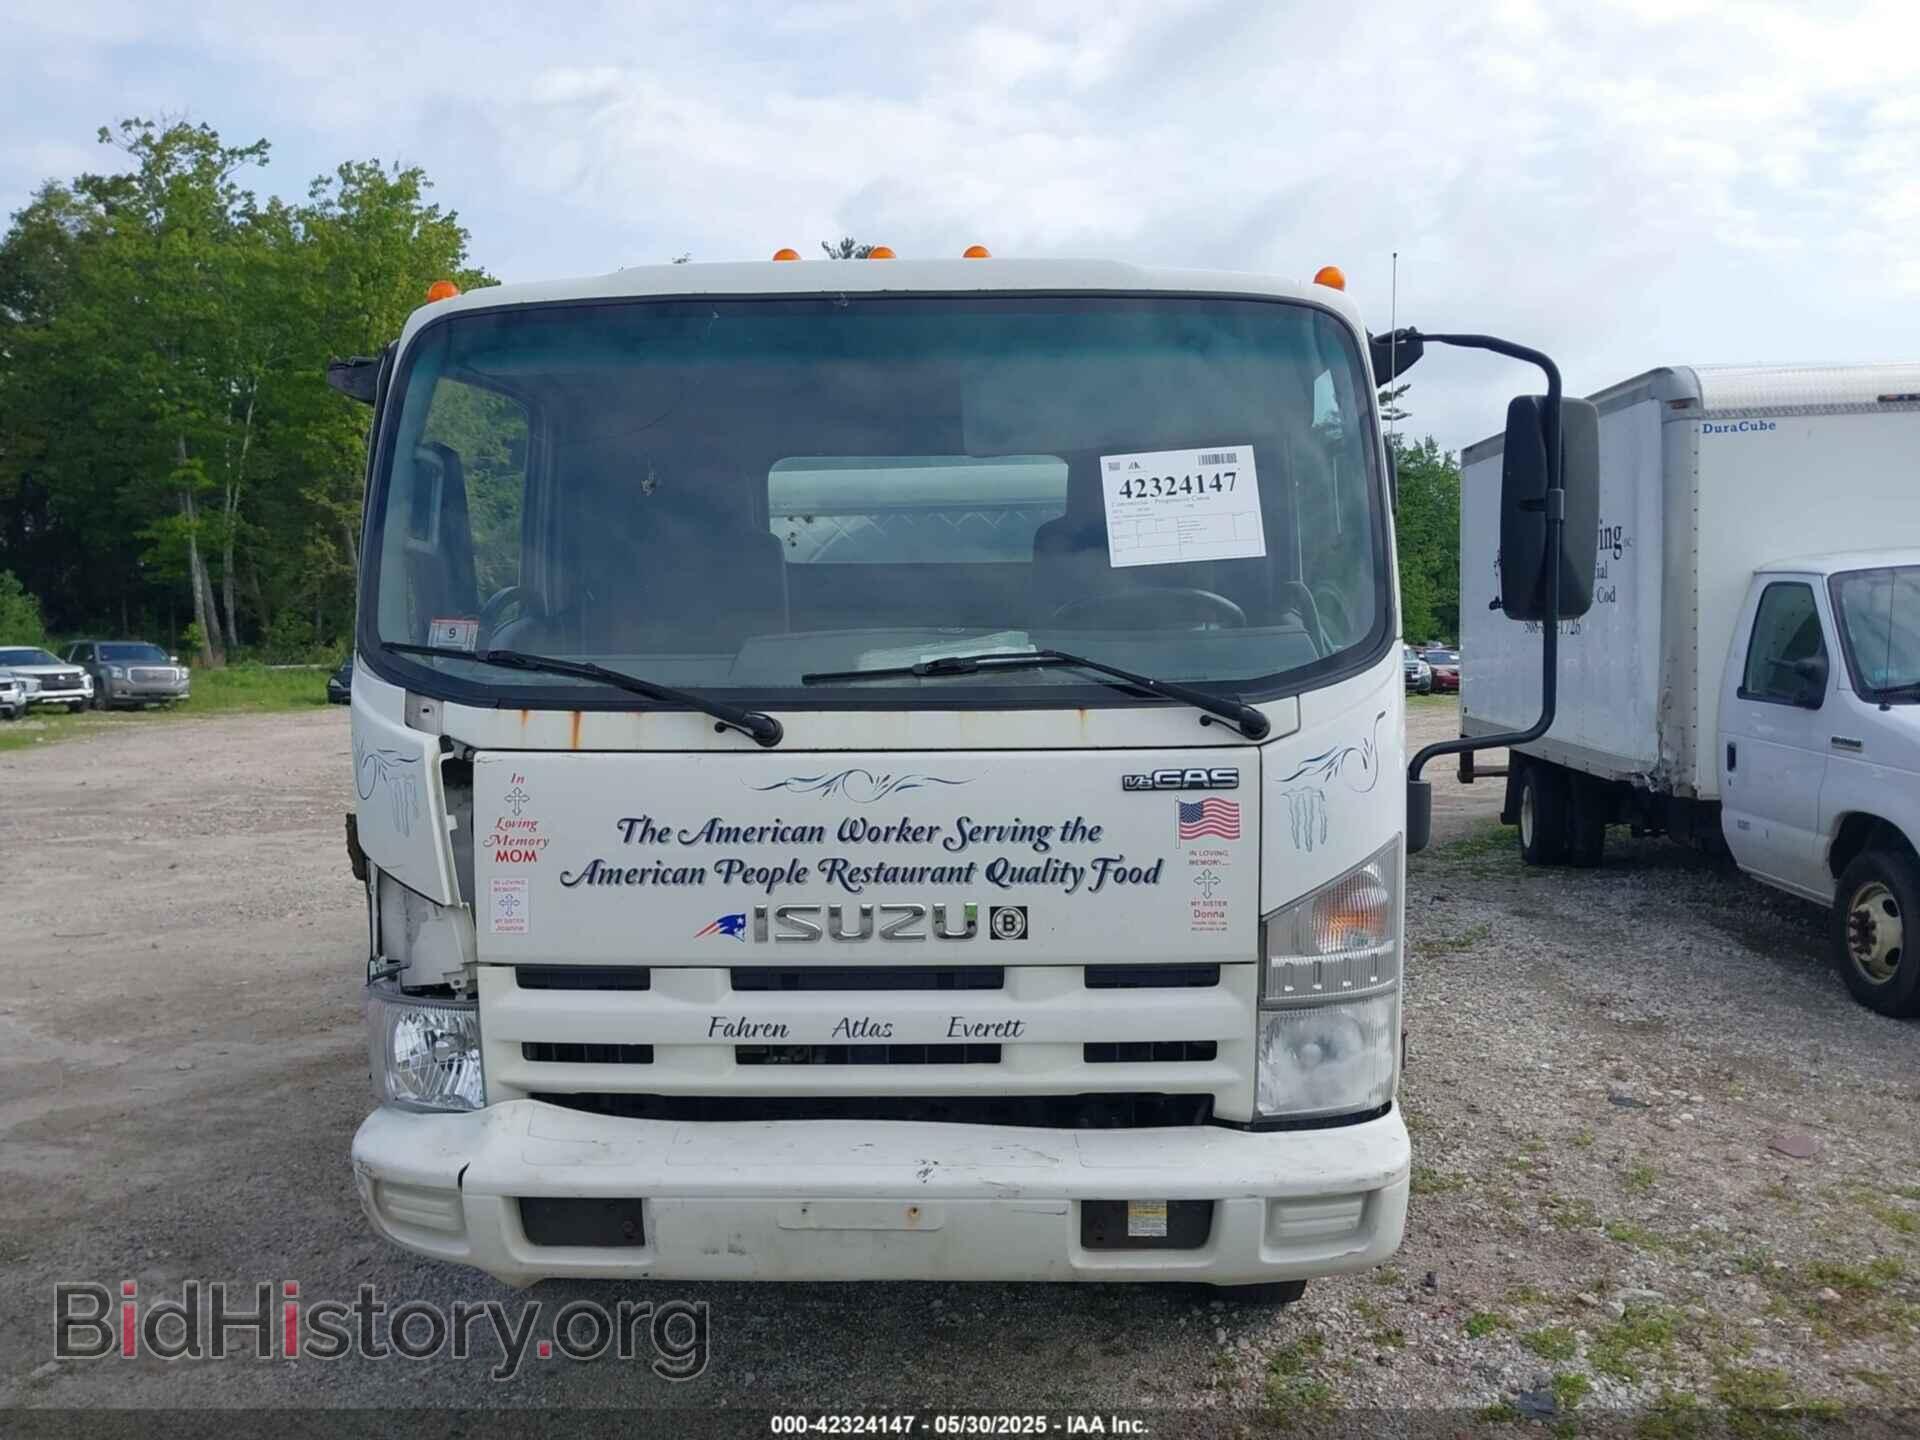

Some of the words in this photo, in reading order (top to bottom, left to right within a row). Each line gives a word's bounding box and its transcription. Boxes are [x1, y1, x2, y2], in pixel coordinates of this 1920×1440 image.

[1703, 421, 1776, 433] DuraCube
[1119, 471, 1237, 499] 42324147
[511, 772, 526, 785] In
[1153, 768, 1239, 789] GAS
[496, 816, 538, 832] Loving
[616, 815, 671, 844] The
[678, 817, 825, 845] American
[836, 816, 941, 843] Worker
[943, 816, 1052, 852] Serving
[1059, 816, 1104, 842] the
[482, 834, 550, 850] Memory
[495, 849, 537, 863] MOM
[560, 858, 705, 886] American
[713, 857, 808, 895] People
[817, 857, 978, 893] Restaurant
[984, 856, 1085, 894] Quality
[1087, 855, 1166, 893] Food
[753, 901, 978, 944] ISUZU
[1193, 909, 1225, 918] Donna
[708, 1016, 791, 1038] Fahren
[832, 1017, 893, 1038] Atlas
[947, 1016, 1025, 1038] Everett
